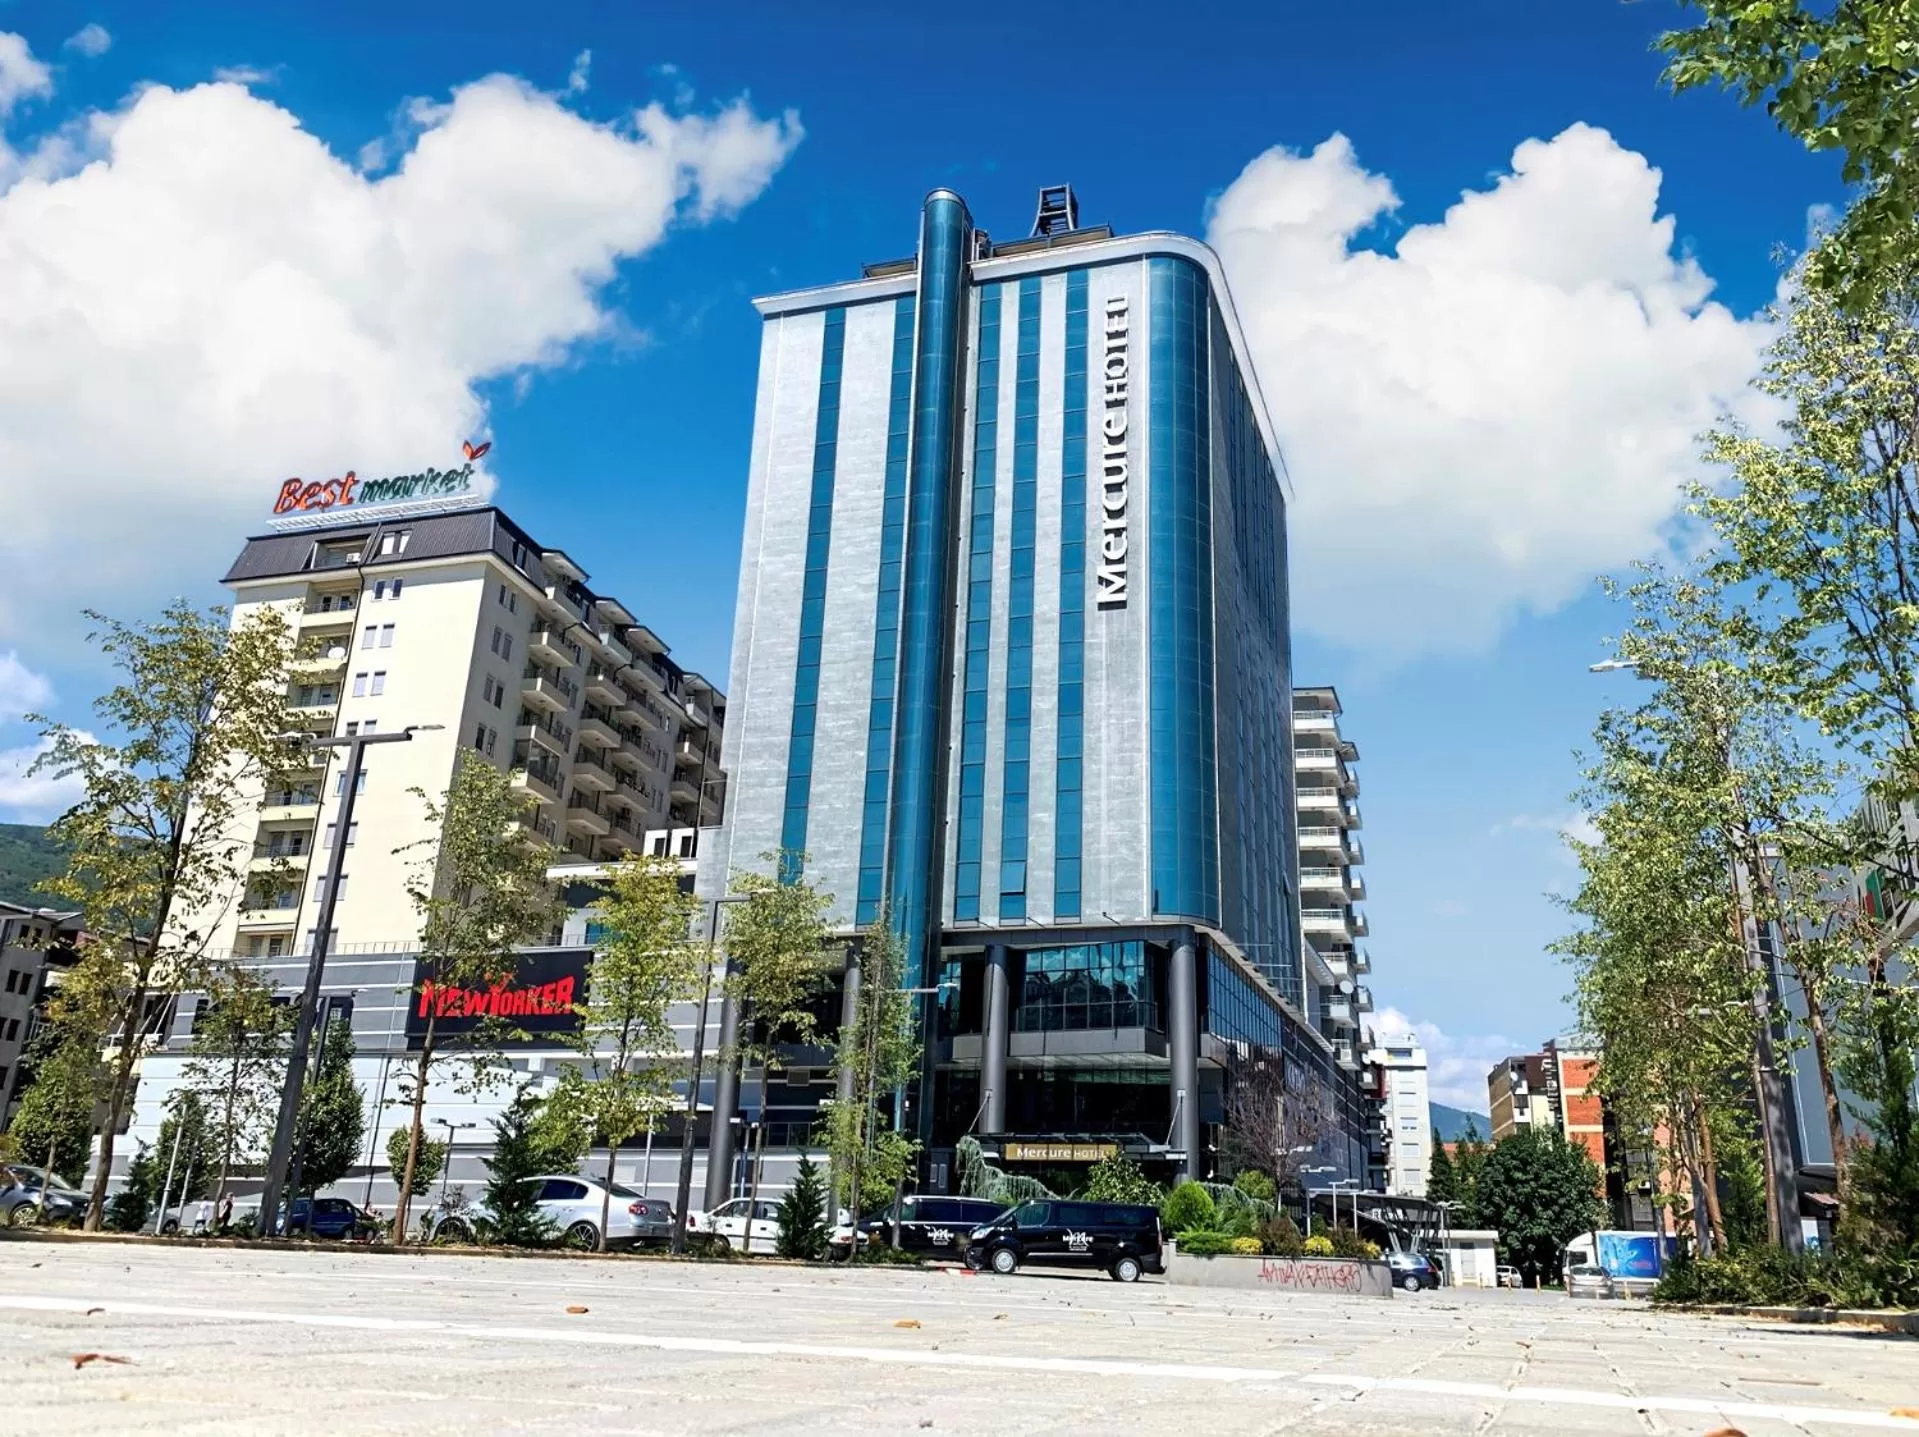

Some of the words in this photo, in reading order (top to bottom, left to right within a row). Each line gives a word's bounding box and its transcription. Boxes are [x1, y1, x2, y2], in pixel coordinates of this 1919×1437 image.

[1104, 296, 1128, 406] HOTEL
[273, 470, 360, 514] Best
[358, 462, 475, 503] market
[1097, 411, 1128, 610] Mercure
[1016, 1147, 1071, 1159] Mercure
[1073, 1148, 1106, 1159] HOTEL
